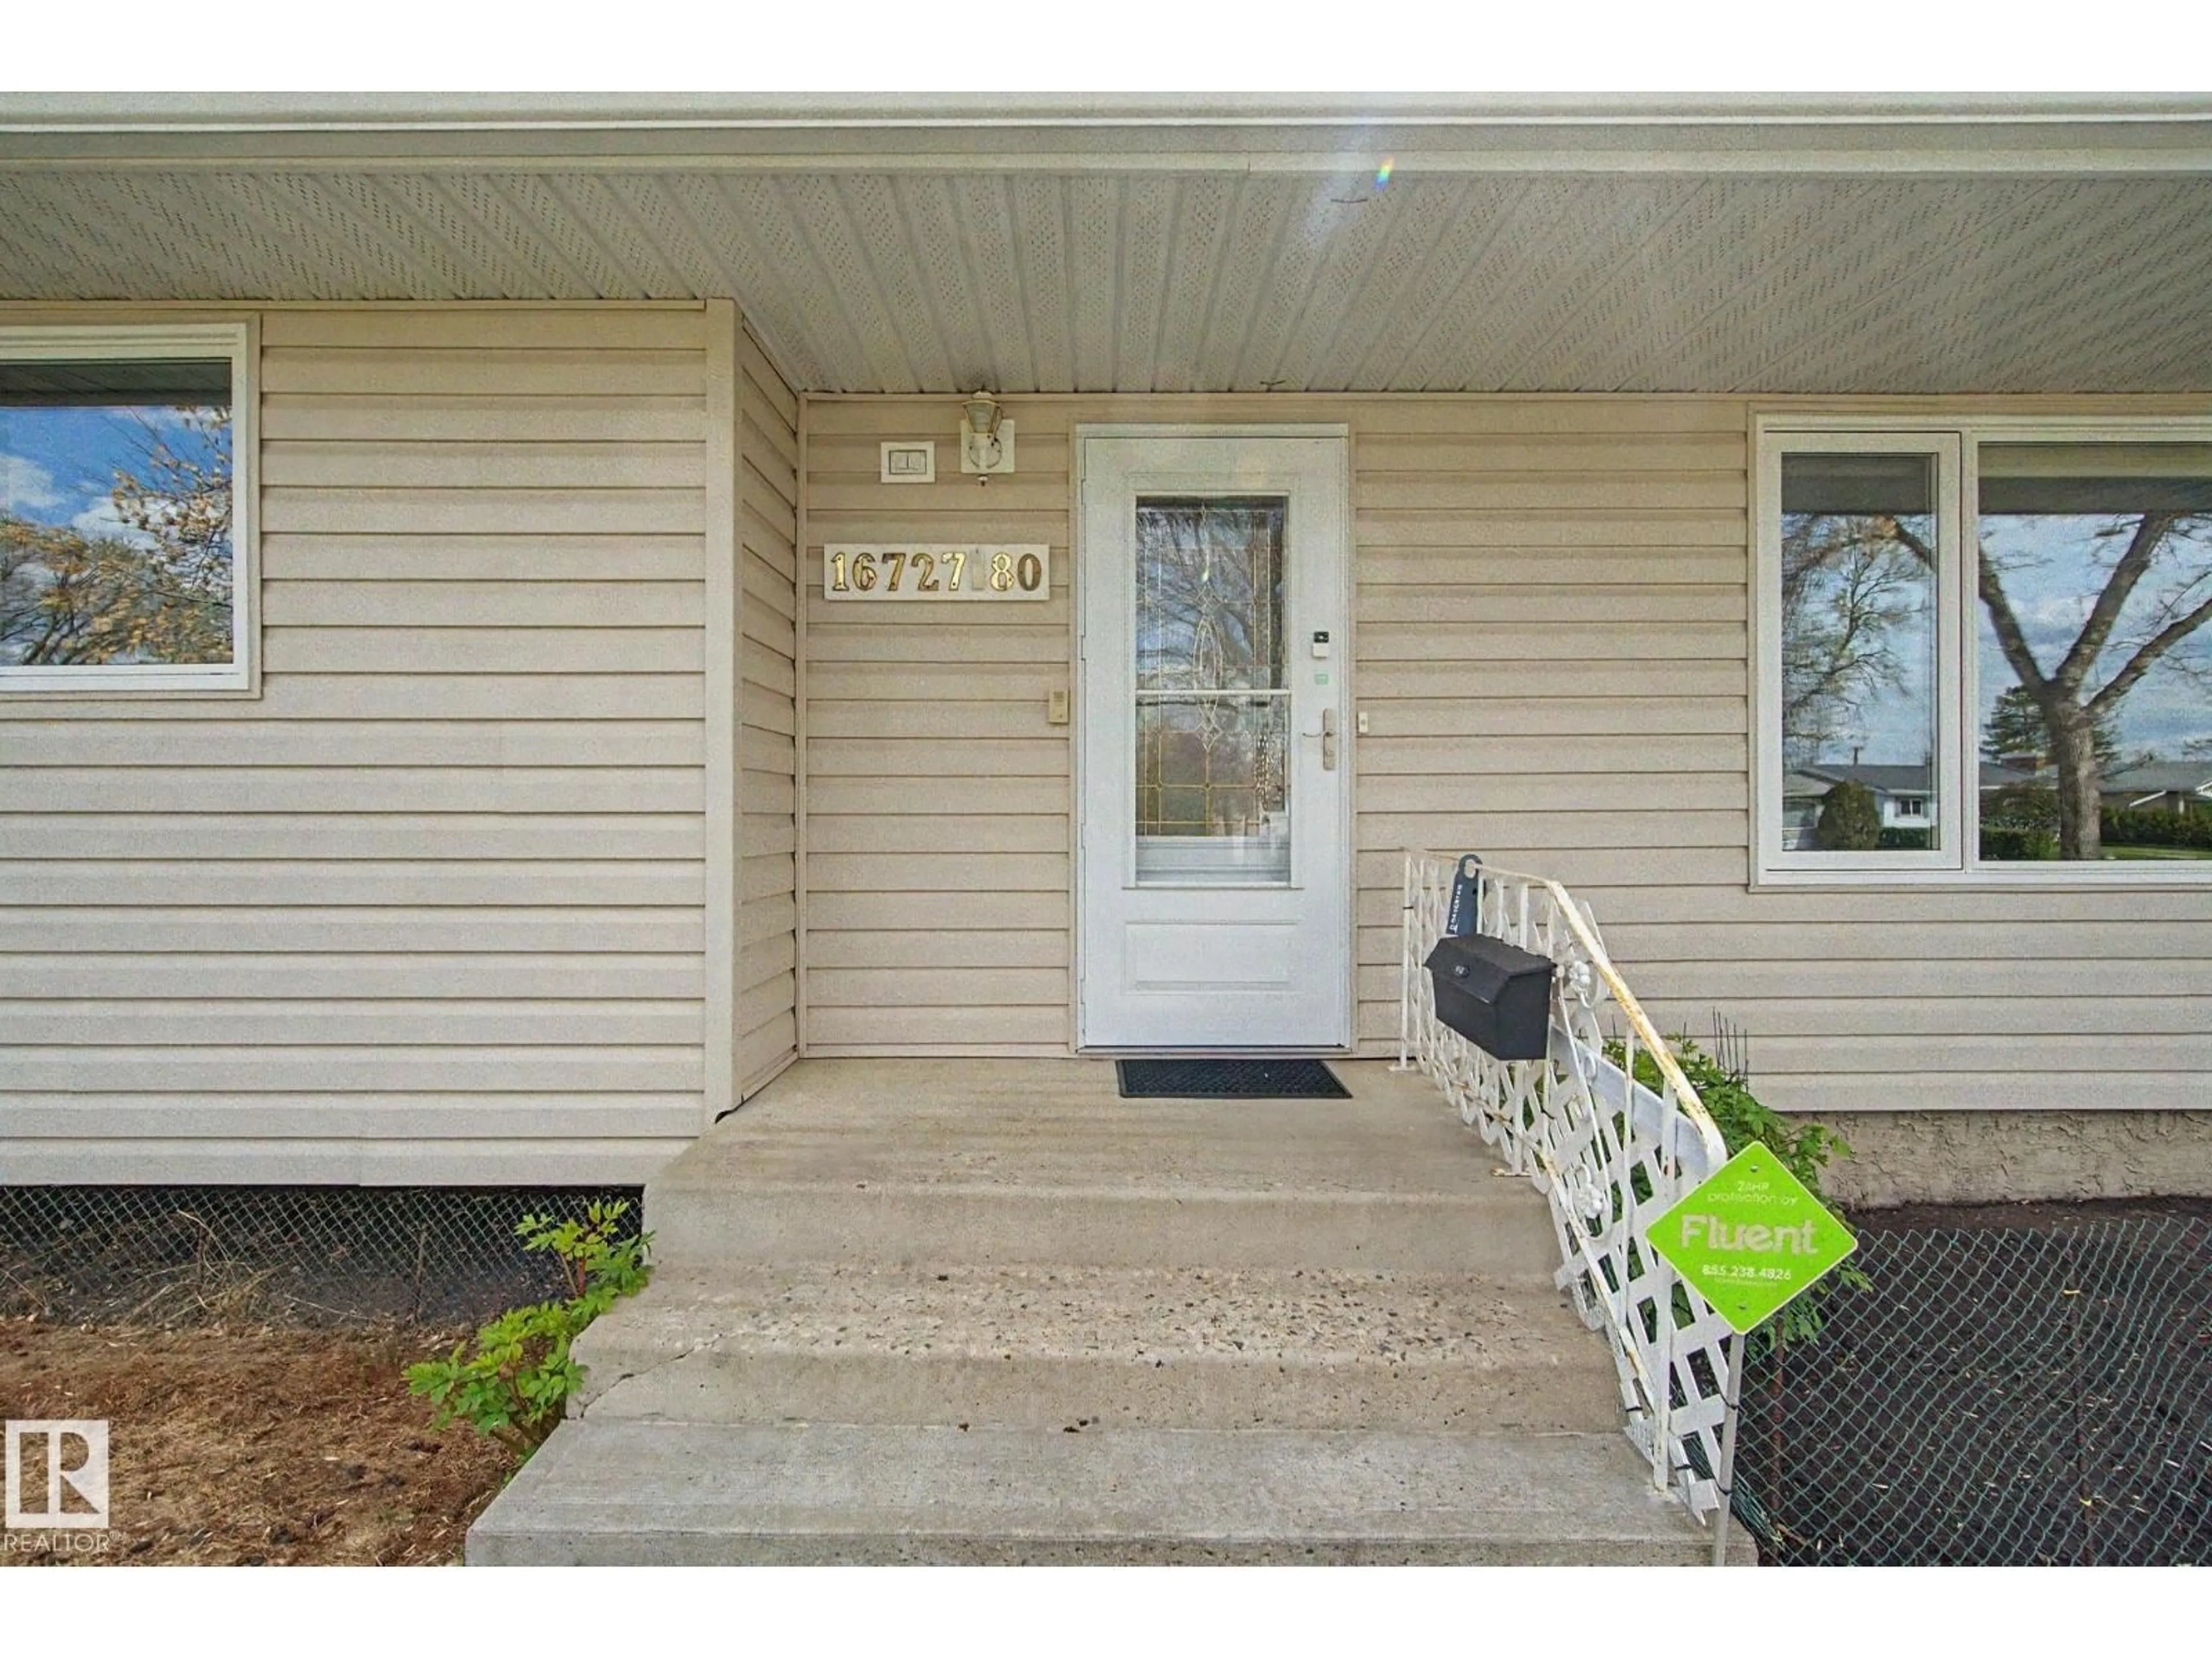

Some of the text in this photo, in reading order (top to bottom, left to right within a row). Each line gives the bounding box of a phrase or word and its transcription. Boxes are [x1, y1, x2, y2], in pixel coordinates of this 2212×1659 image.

[831, 551, 1042, 591] 16727 80
[1681, 1214, 1819, 1255] Fluent
